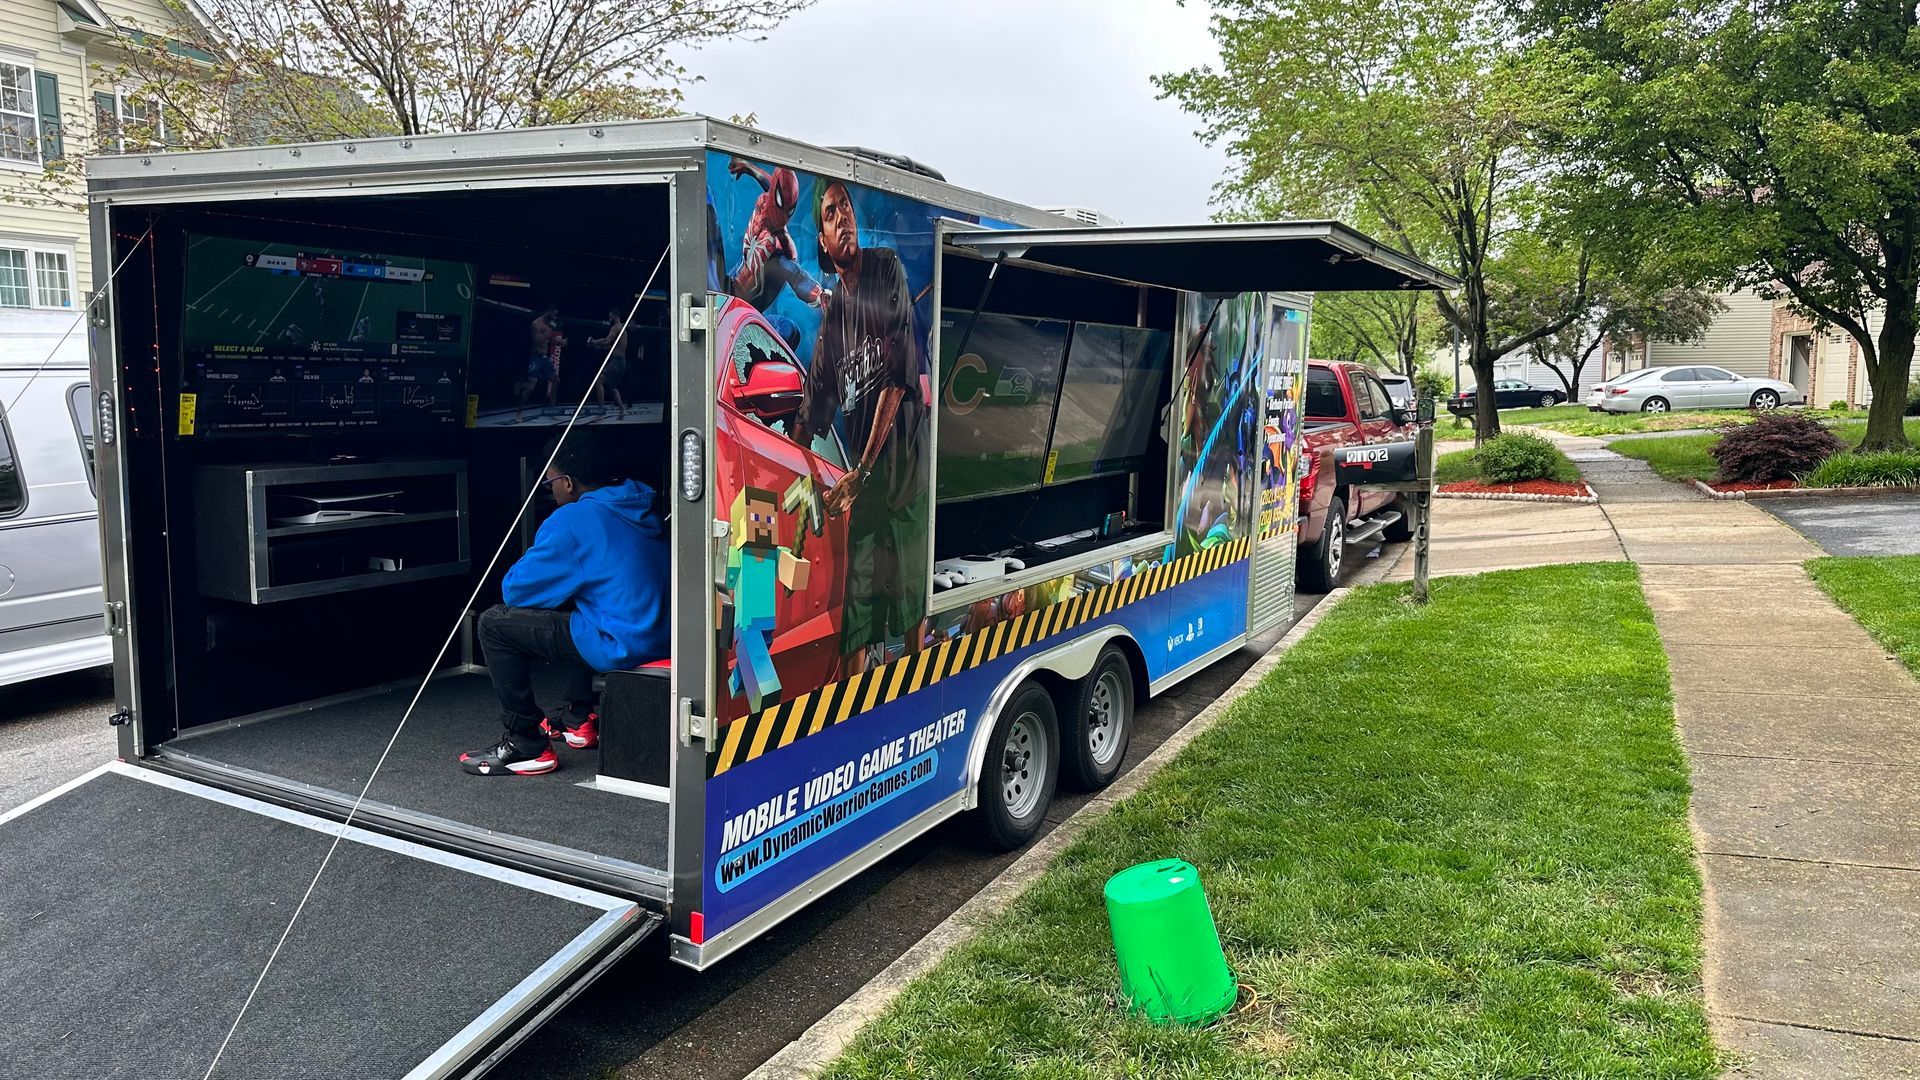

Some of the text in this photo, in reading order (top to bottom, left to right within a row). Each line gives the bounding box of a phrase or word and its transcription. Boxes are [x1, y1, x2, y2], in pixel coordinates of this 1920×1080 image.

[331, 263, 338, 272] 7
[1348, 449, 1387, 462] 9102
[720, 708, 967, 854] MOBILE VIDEO GAME THEATER
